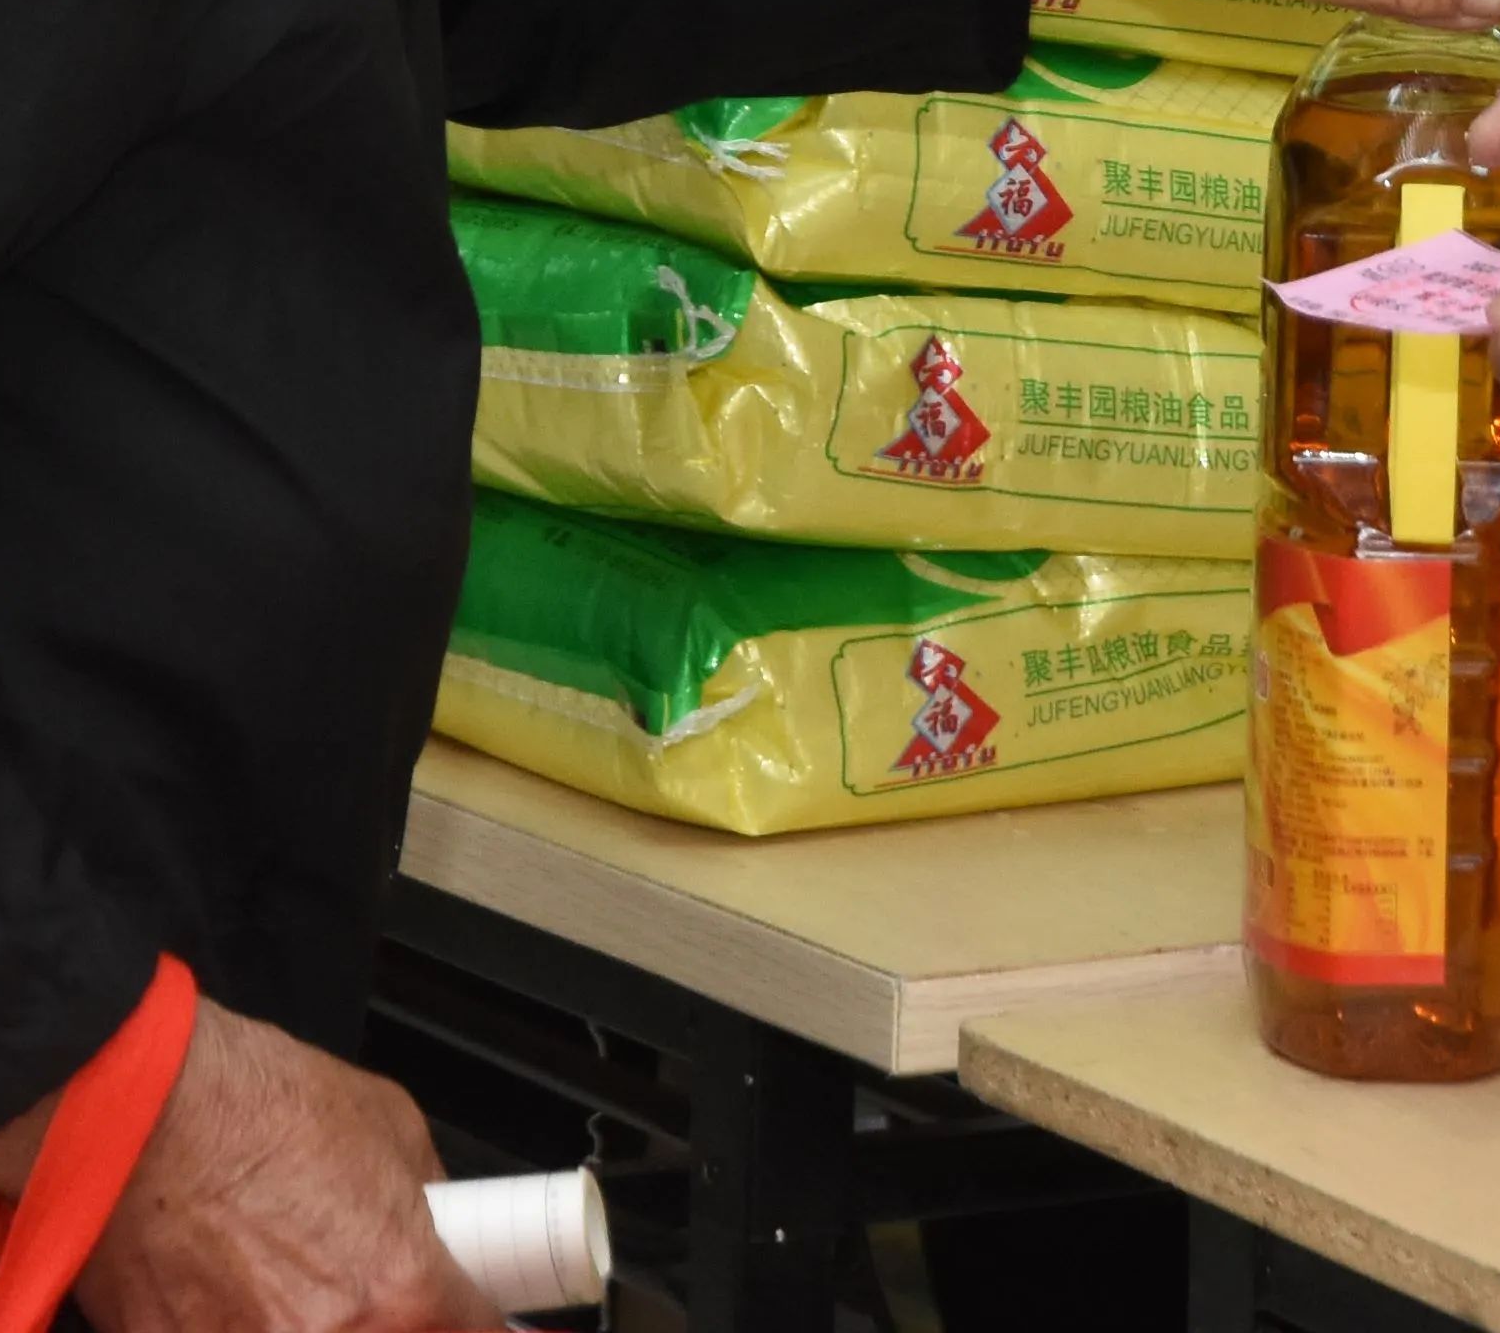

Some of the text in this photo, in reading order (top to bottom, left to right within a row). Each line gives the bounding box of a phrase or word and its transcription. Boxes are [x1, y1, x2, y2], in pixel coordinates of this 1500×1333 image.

[1103, 159, 1262, 214] 聚丰园粮油
[1018, 377, 1251, 430] 聚丰园粮油食品
